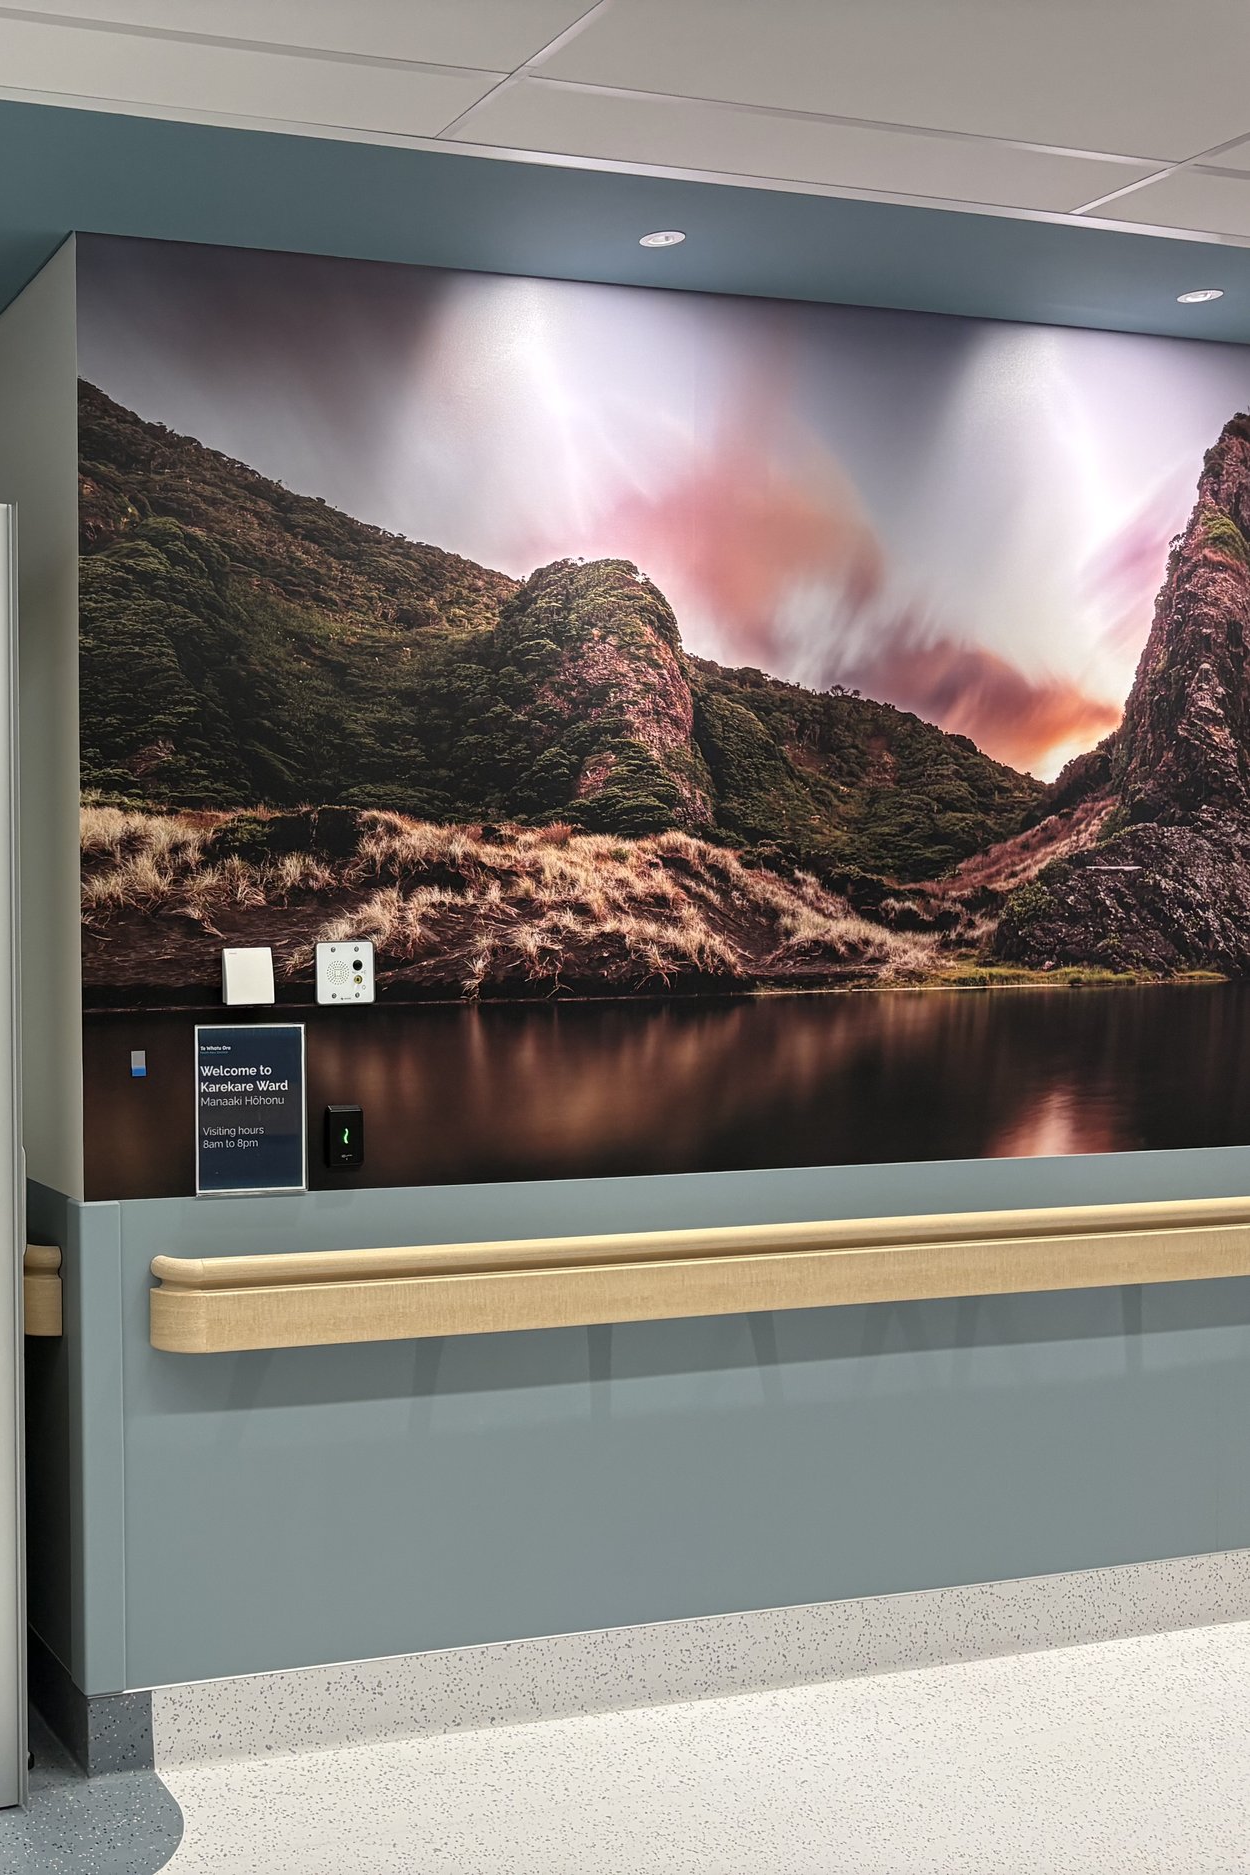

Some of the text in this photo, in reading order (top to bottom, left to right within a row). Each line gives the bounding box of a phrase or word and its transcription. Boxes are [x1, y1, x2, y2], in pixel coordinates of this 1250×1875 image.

[200, 1064, 272, 1077] Welcome to
[200, 1080, 289, 1093] Karekare Ward
[200, 1095, 285, 1107] Manaaki Hōhonu
[203, 1126, 265, 1137] Visiting hours
[203, 1139, 259, 1149] 8am to 8pm
